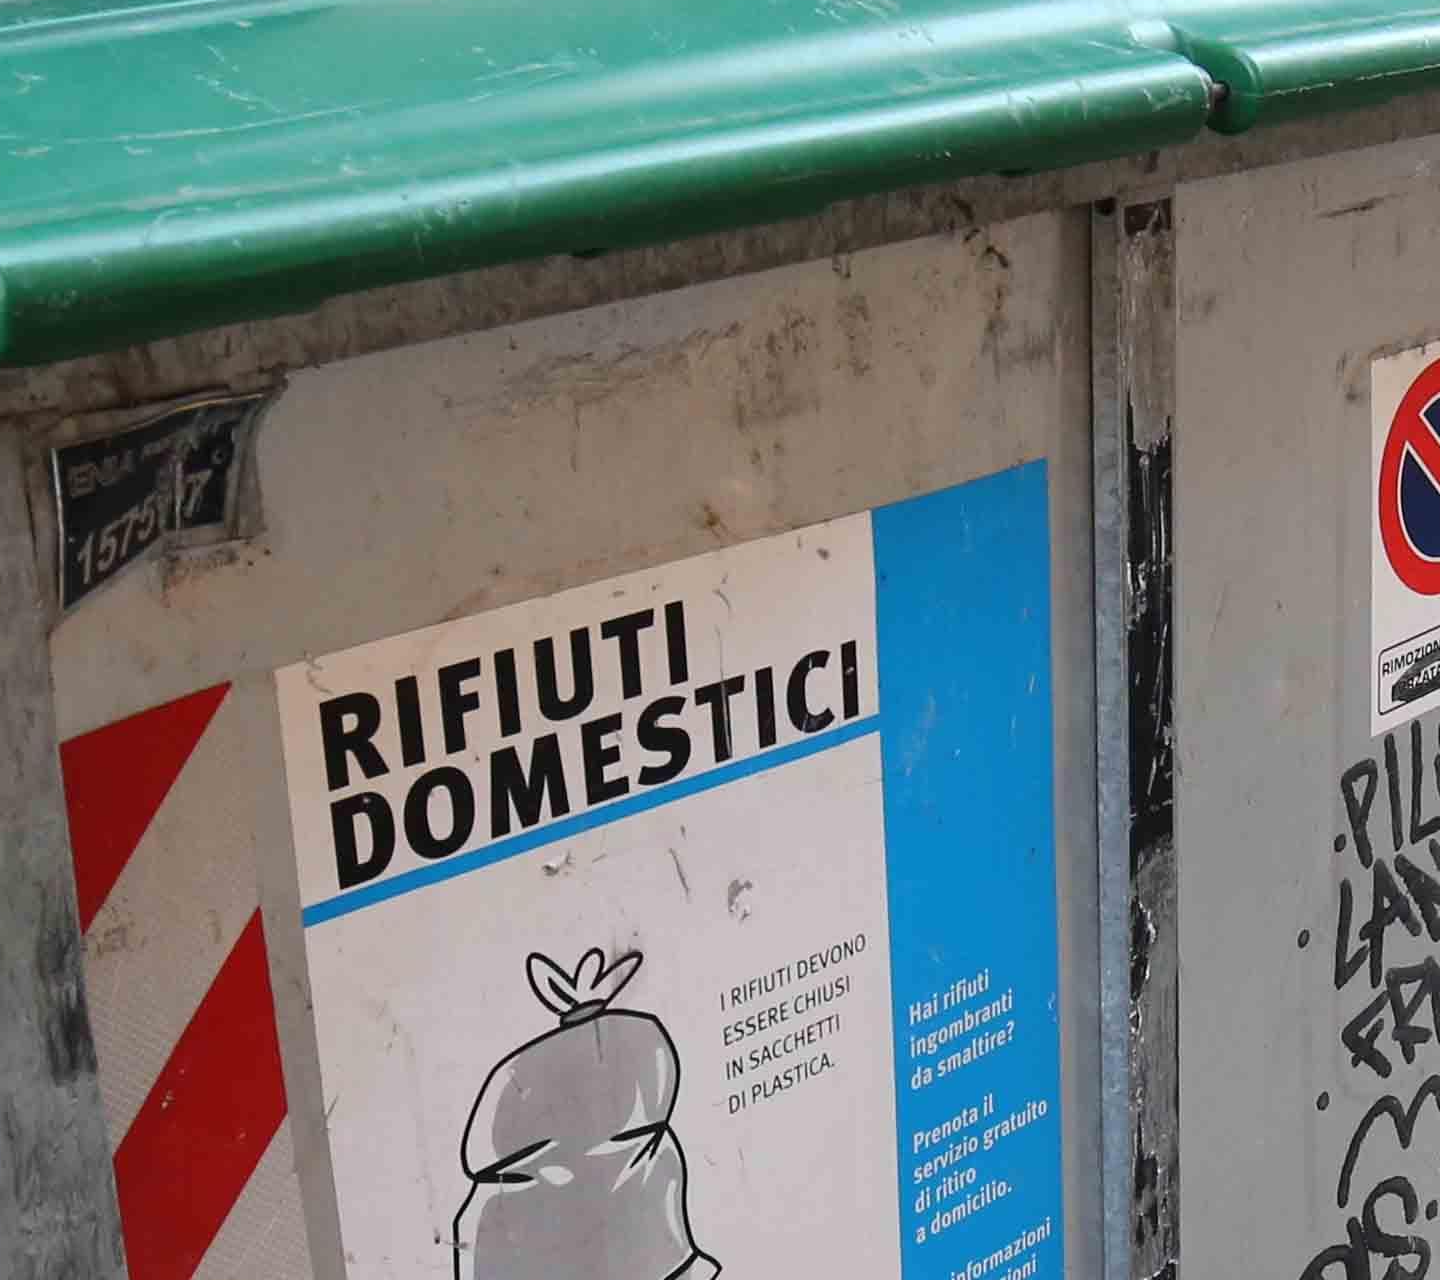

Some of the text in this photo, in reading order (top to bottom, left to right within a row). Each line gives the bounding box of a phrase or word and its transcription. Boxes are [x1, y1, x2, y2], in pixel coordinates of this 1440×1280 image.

[318, 601, 690, 791] RIFIUTI
[329, 639, 861, 891] DOMESTICI
[719, 933, 867, 1013] I RIFIUTI DEVONO
[909, 967, 990, 1026] Hai rifiuti
[722, 974, 851, 1047] ESSERE CHIUSI
[909, 987, 1014, 1059] ingombranti
[725, 1012, 841, 1081] IN SACCHETTI
[910, 1020, 1016, 1091] da smaltire?
[728, 1051, 836, 1115] DI PLASTICA.
[912, 1092, 995, 1155] Prenota il
[912, 1098, 1049, 1186] servizio gratuito
[914, 1166, 977, 1215] di ritiro
[916, 1177, 1013, 1245] a domicilio.
